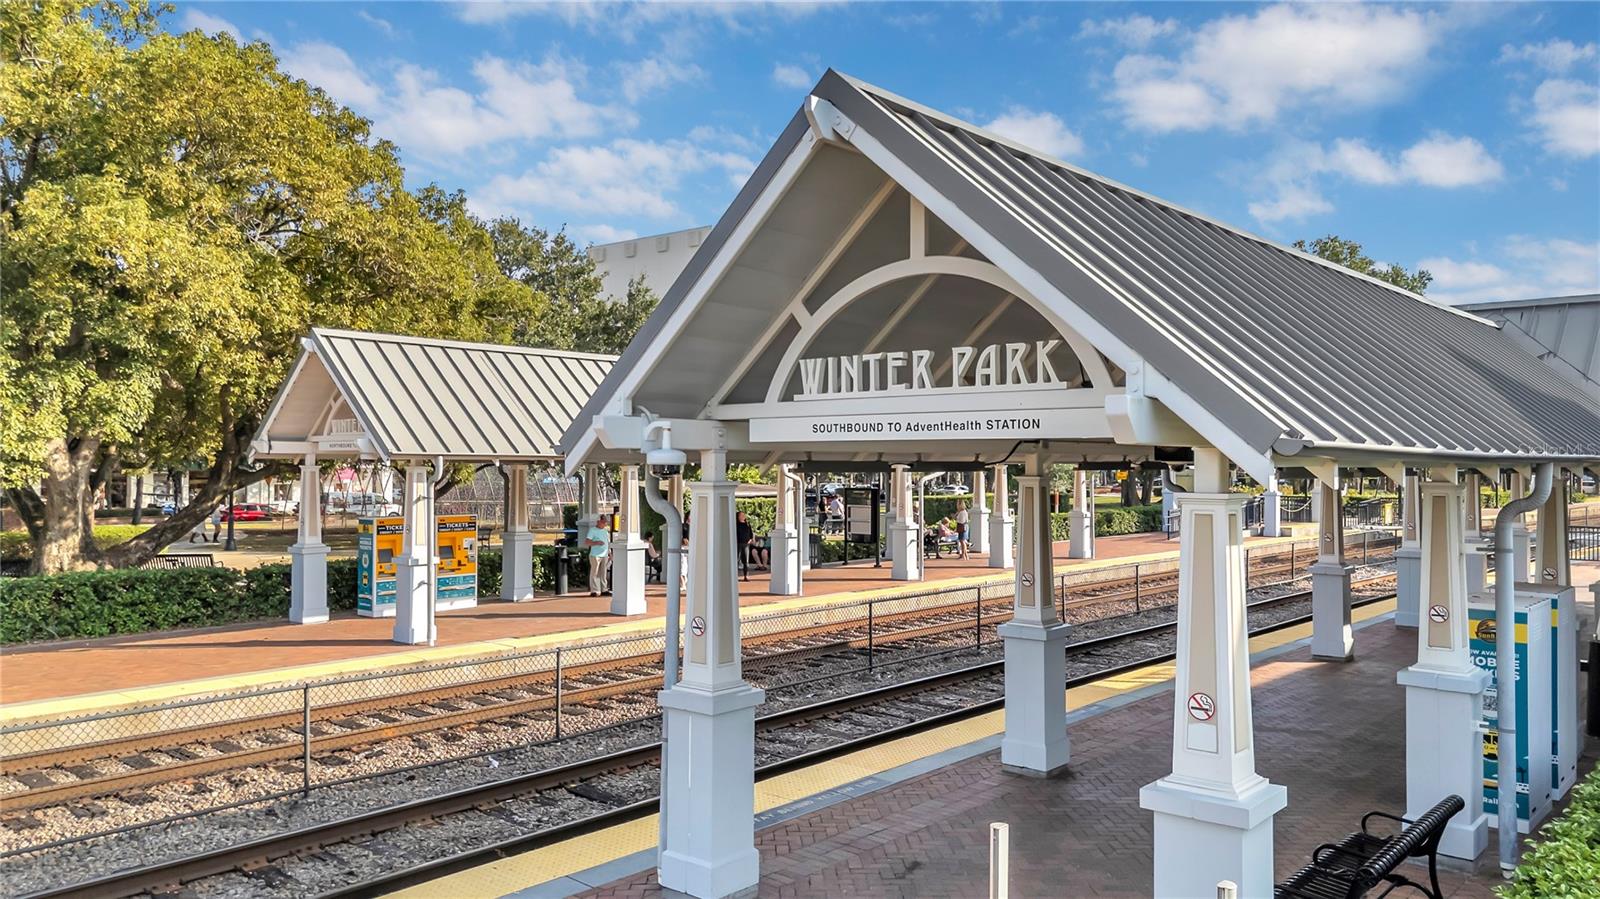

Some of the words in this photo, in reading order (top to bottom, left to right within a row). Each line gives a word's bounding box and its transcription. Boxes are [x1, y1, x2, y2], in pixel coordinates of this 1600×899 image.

[799, 351, 935, 396] WINTER
[952, 340, 1062, 388] PARK
[811, 422, 884, 434] SOUTHBOUND
[887, 422, 902, 432] TO
[905, 420, 982, 432] AdventHealth
[986, 418, 1041, 430] STATION
